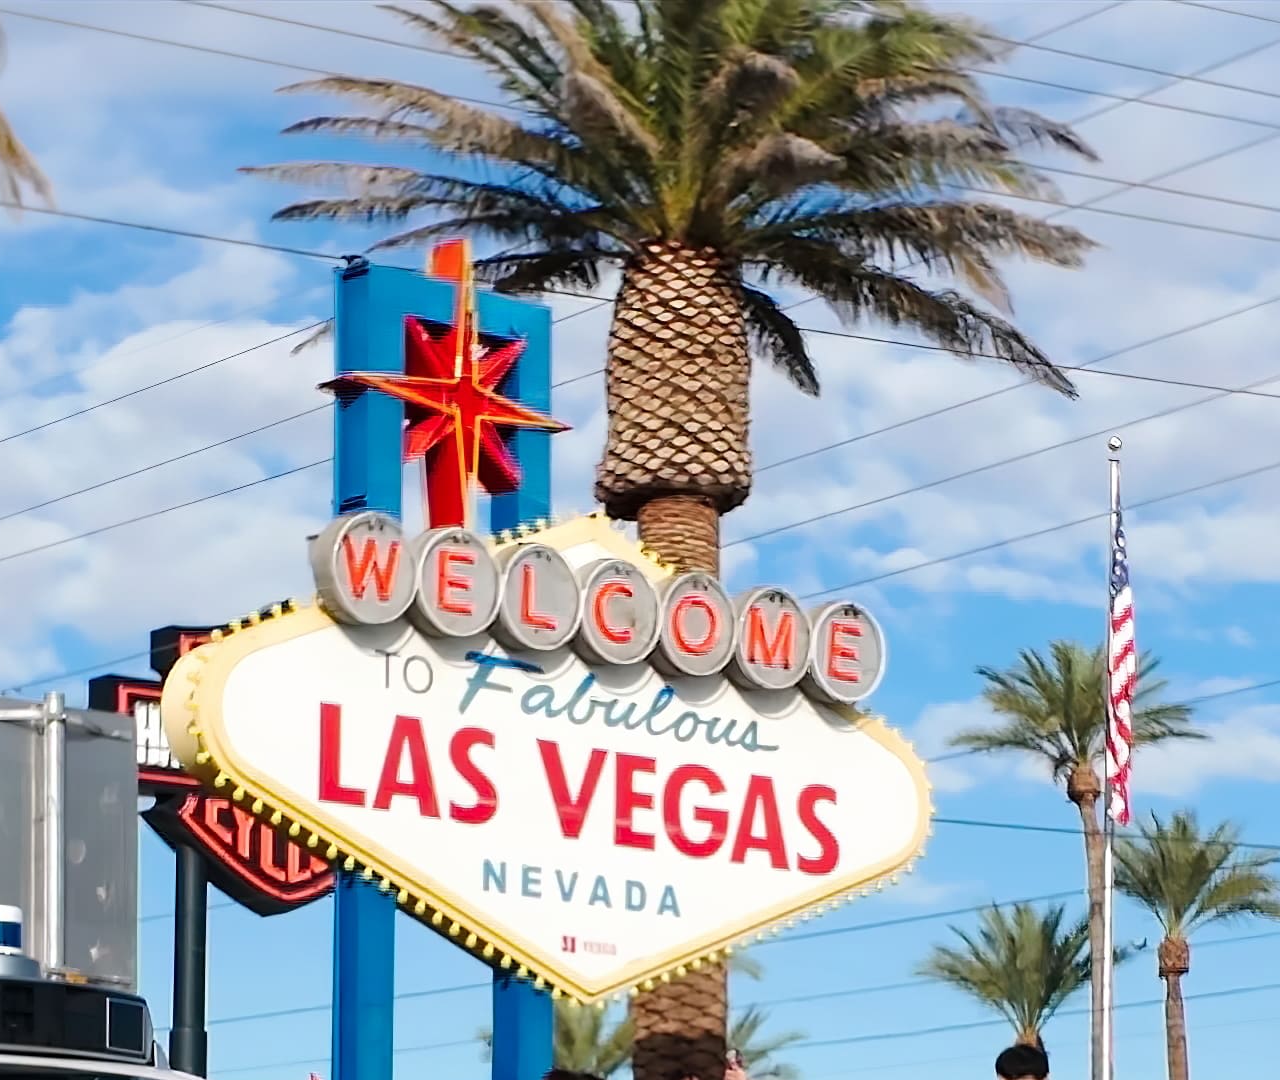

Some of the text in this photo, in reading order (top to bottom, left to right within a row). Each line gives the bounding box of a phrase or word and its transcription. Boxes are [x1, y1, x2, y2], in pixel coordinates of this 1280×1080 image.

[342, 534, 864, 684] WELCOME
[375, 649, 779, 752] TO Fabulous
[318, 701, 501, 825] LAS
[535, 737, 841, 876] VEGAS
[481, 857, 683, 918] NEVADA
